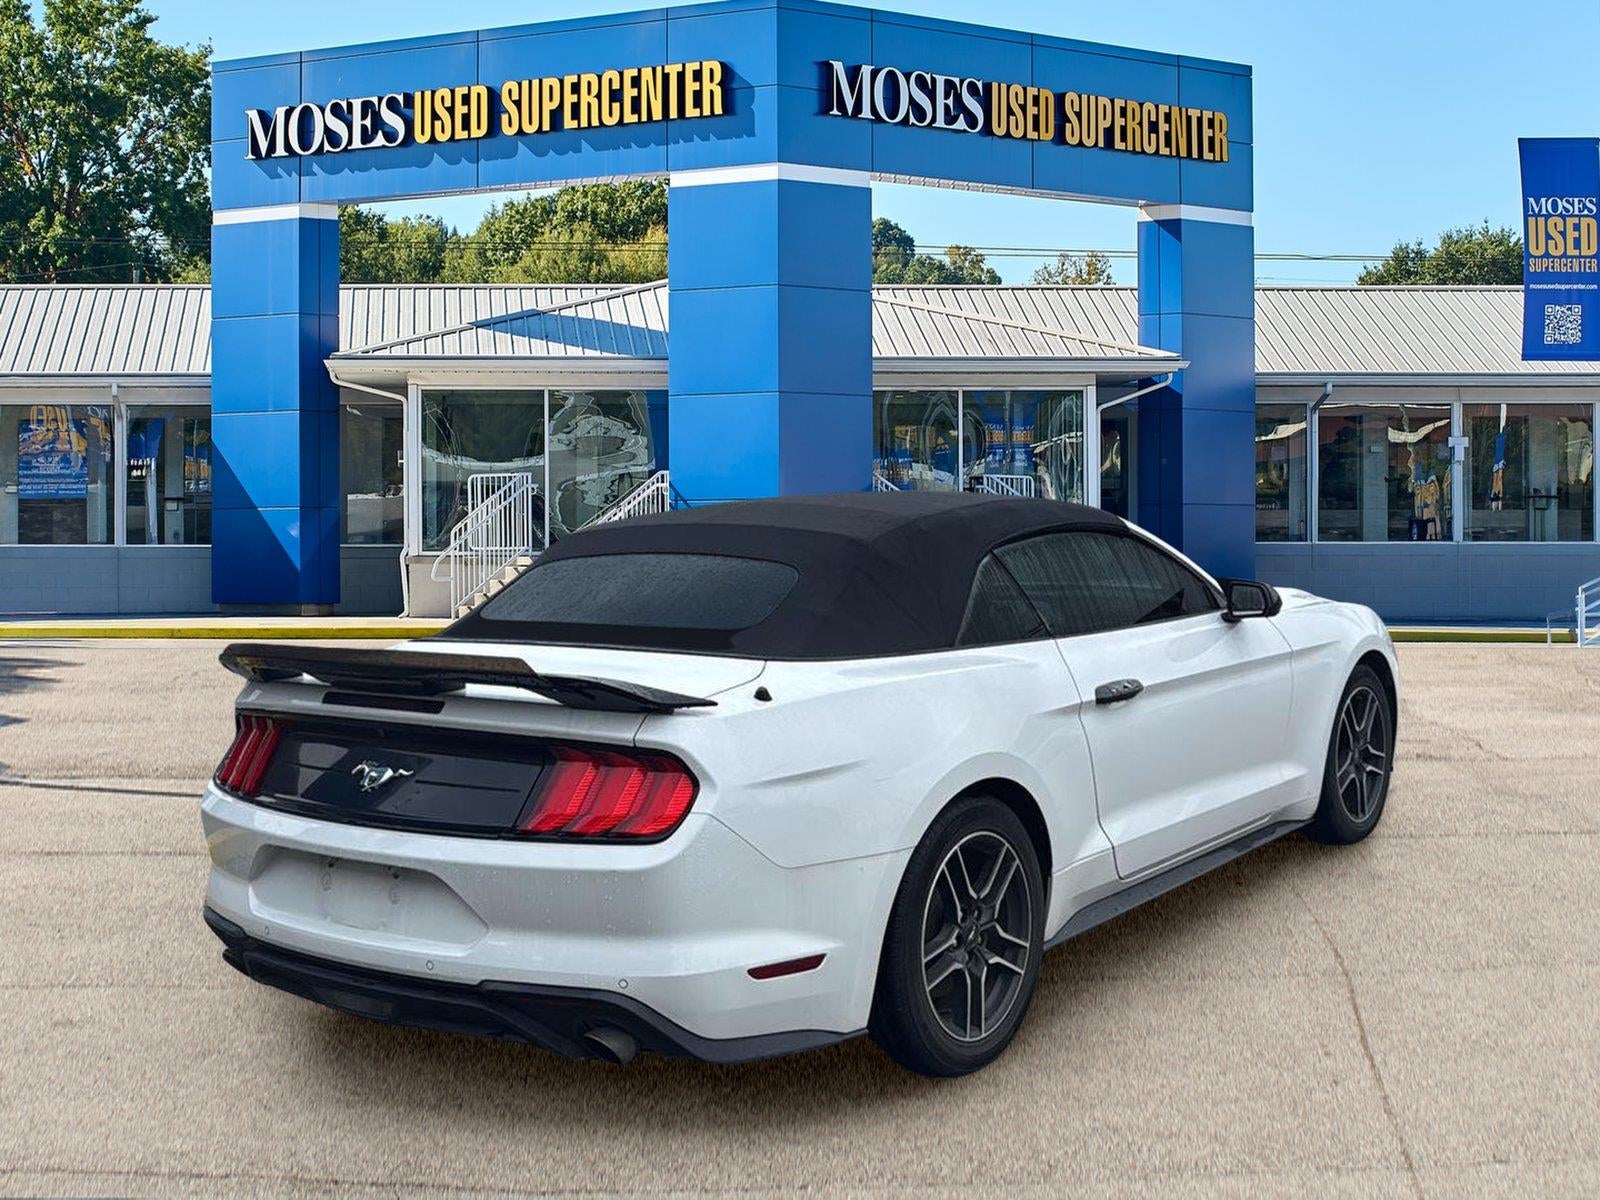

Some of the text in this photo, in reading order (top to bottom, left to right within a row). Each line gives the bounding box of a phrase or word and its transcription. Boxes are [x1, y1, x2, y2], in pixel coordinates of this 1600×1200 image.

[244, 59, 724, 160] MOSES USED SUPERCENTER
[828, 60, 1229, 163] MOSES USED SUPERCENTER
[1527, 197, 1597, 215] MOSES
[1529, 217, 1598, 256] USED
[1529, 258, 1598, 273] SUPERCENTER
